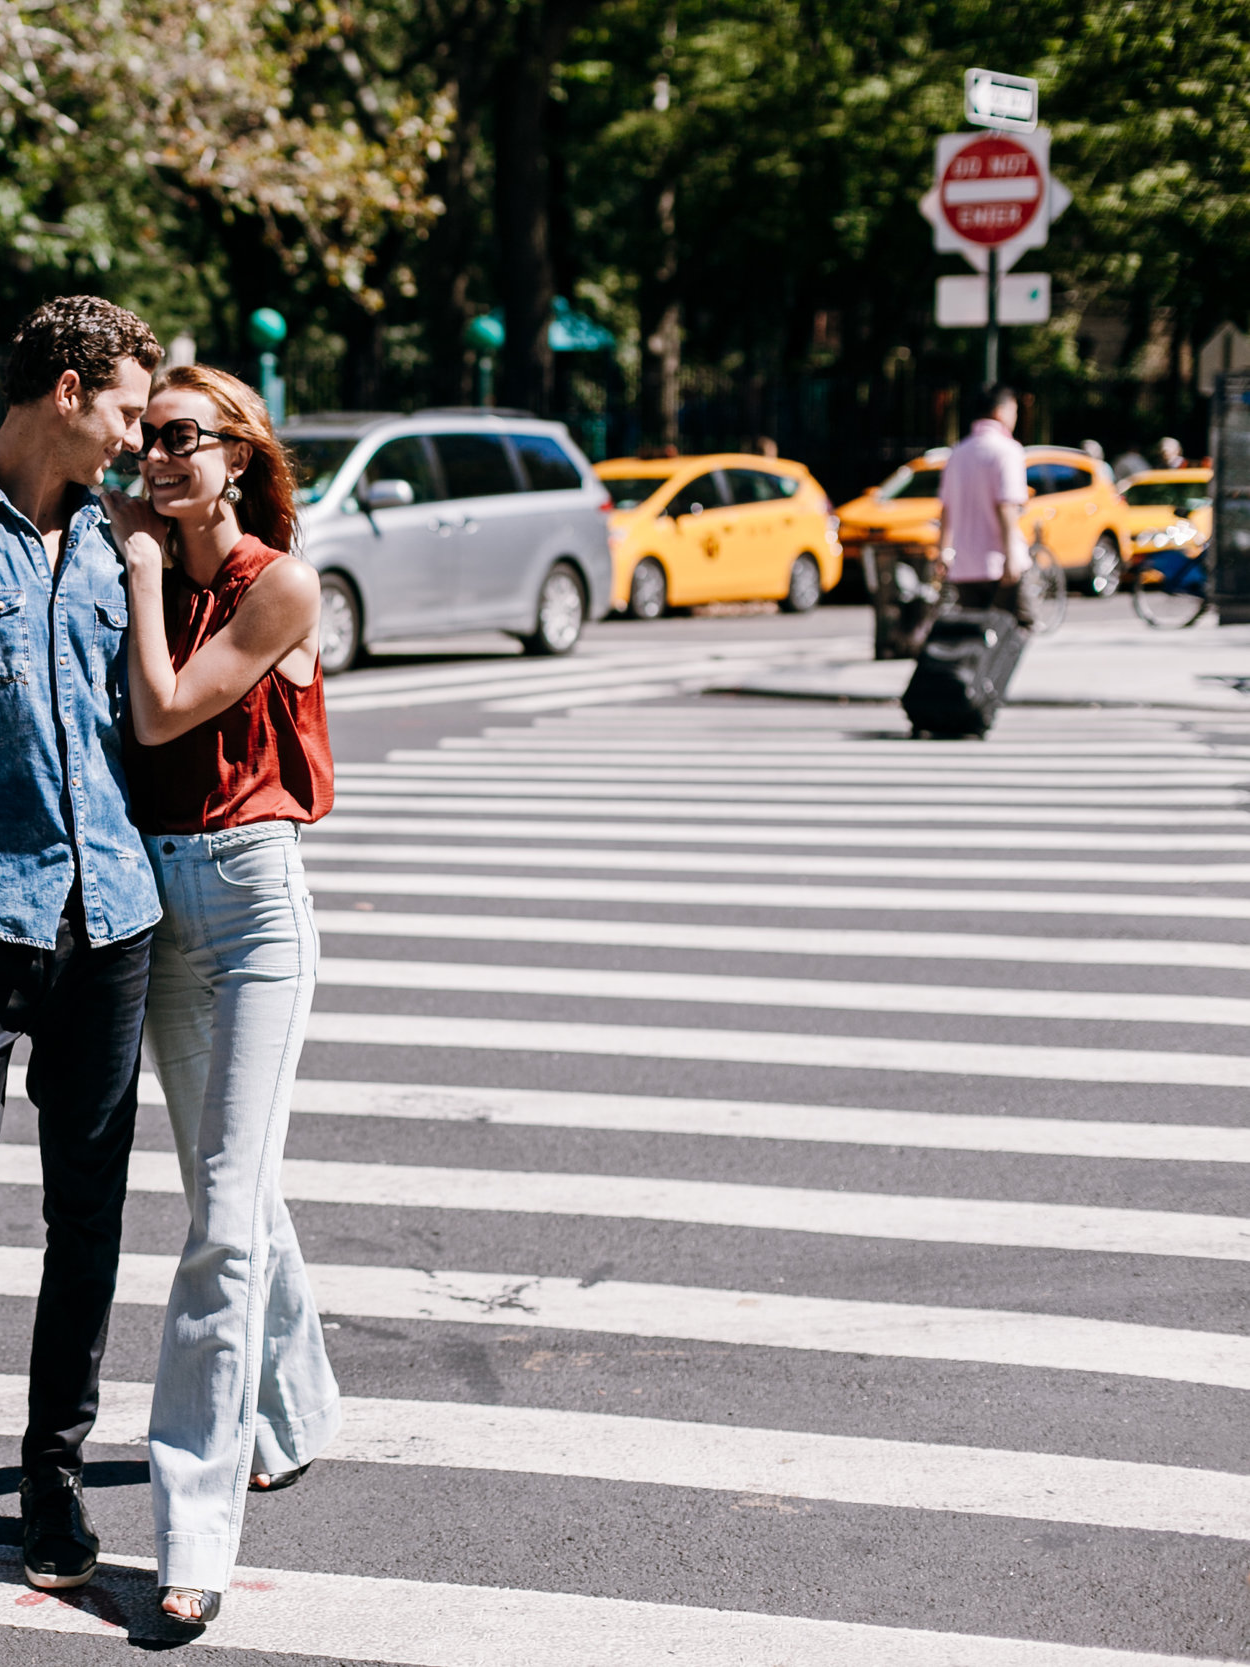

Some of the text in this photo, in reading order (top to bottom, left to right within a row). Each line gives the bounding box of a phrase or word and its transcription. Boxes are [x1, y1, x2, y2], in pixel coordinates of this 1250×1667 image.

[952, 153, 1029, 179] DO NOT
[956, 205, 1023, 229] ENTER
